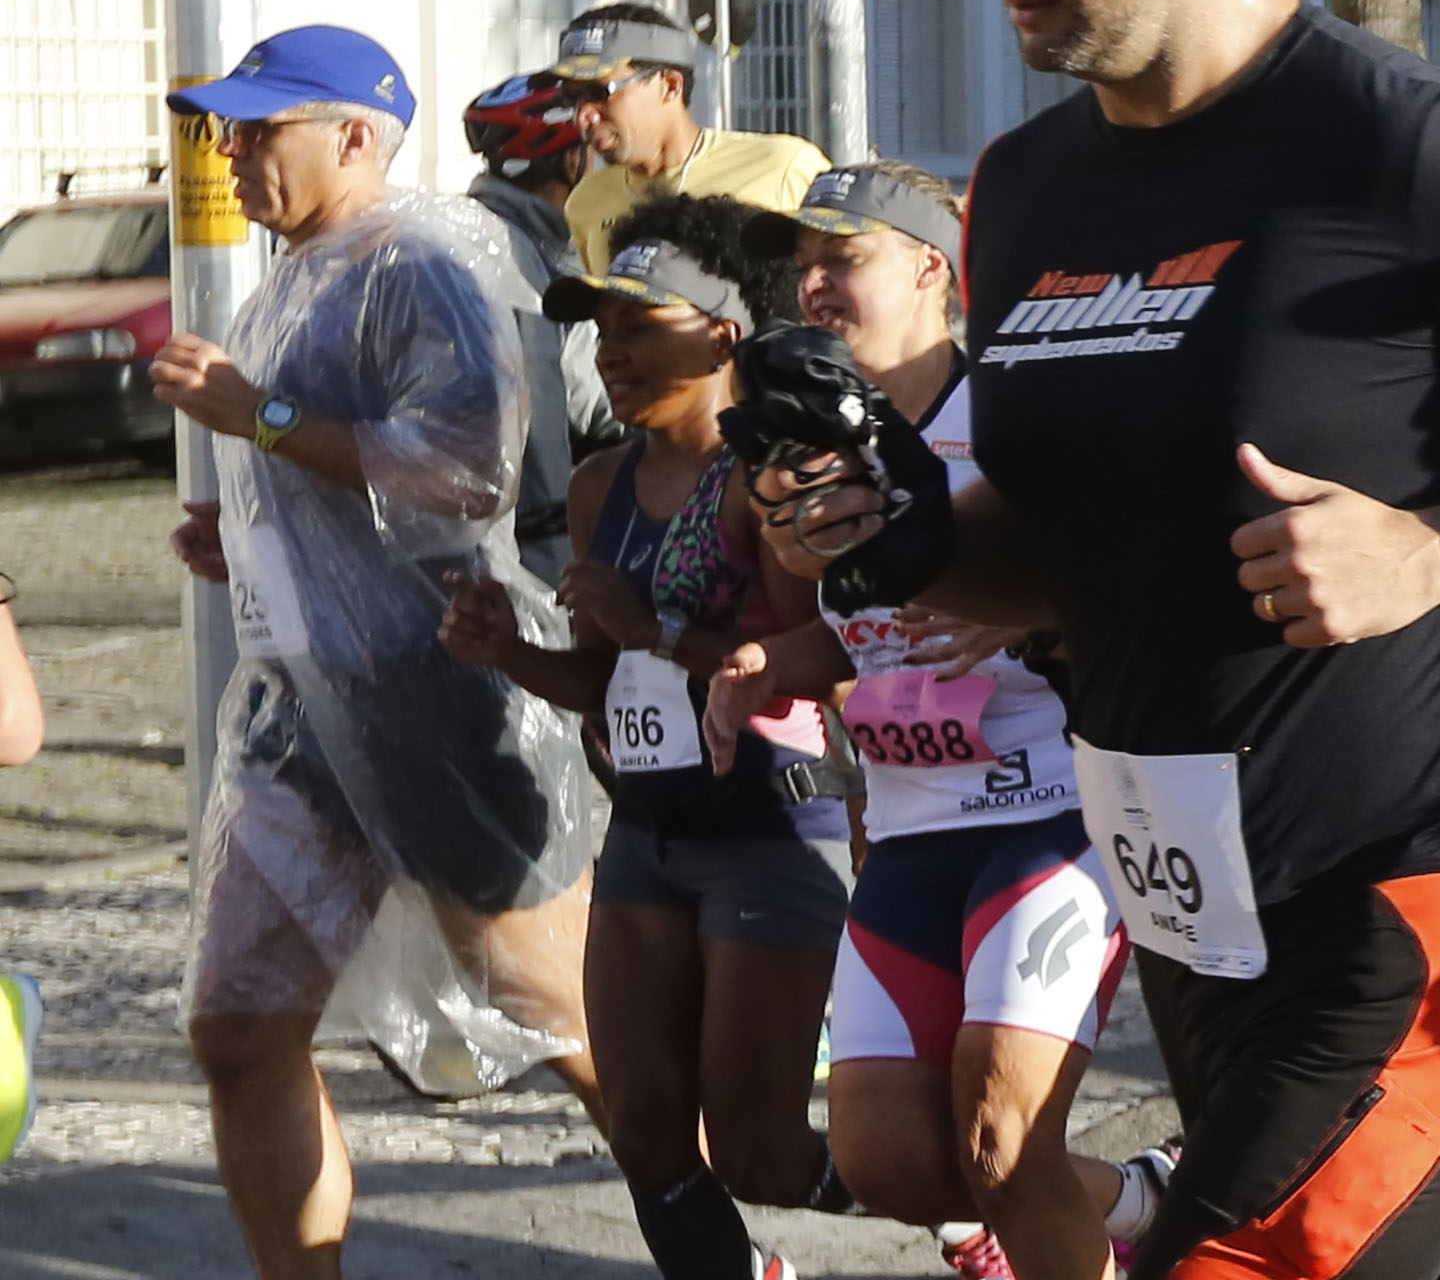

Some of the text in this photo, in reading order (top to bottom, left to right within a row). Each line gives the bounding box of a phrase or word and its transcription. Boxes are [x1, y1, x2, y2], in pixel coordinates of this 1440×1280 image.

[996, 272, 1216, 333] millen
[1027, 271, 1112, 298] New
[613, 705, 665, 748] 766
[853, 719, 975, 765] 3388
[1113, 833, 1203, 914] 649
